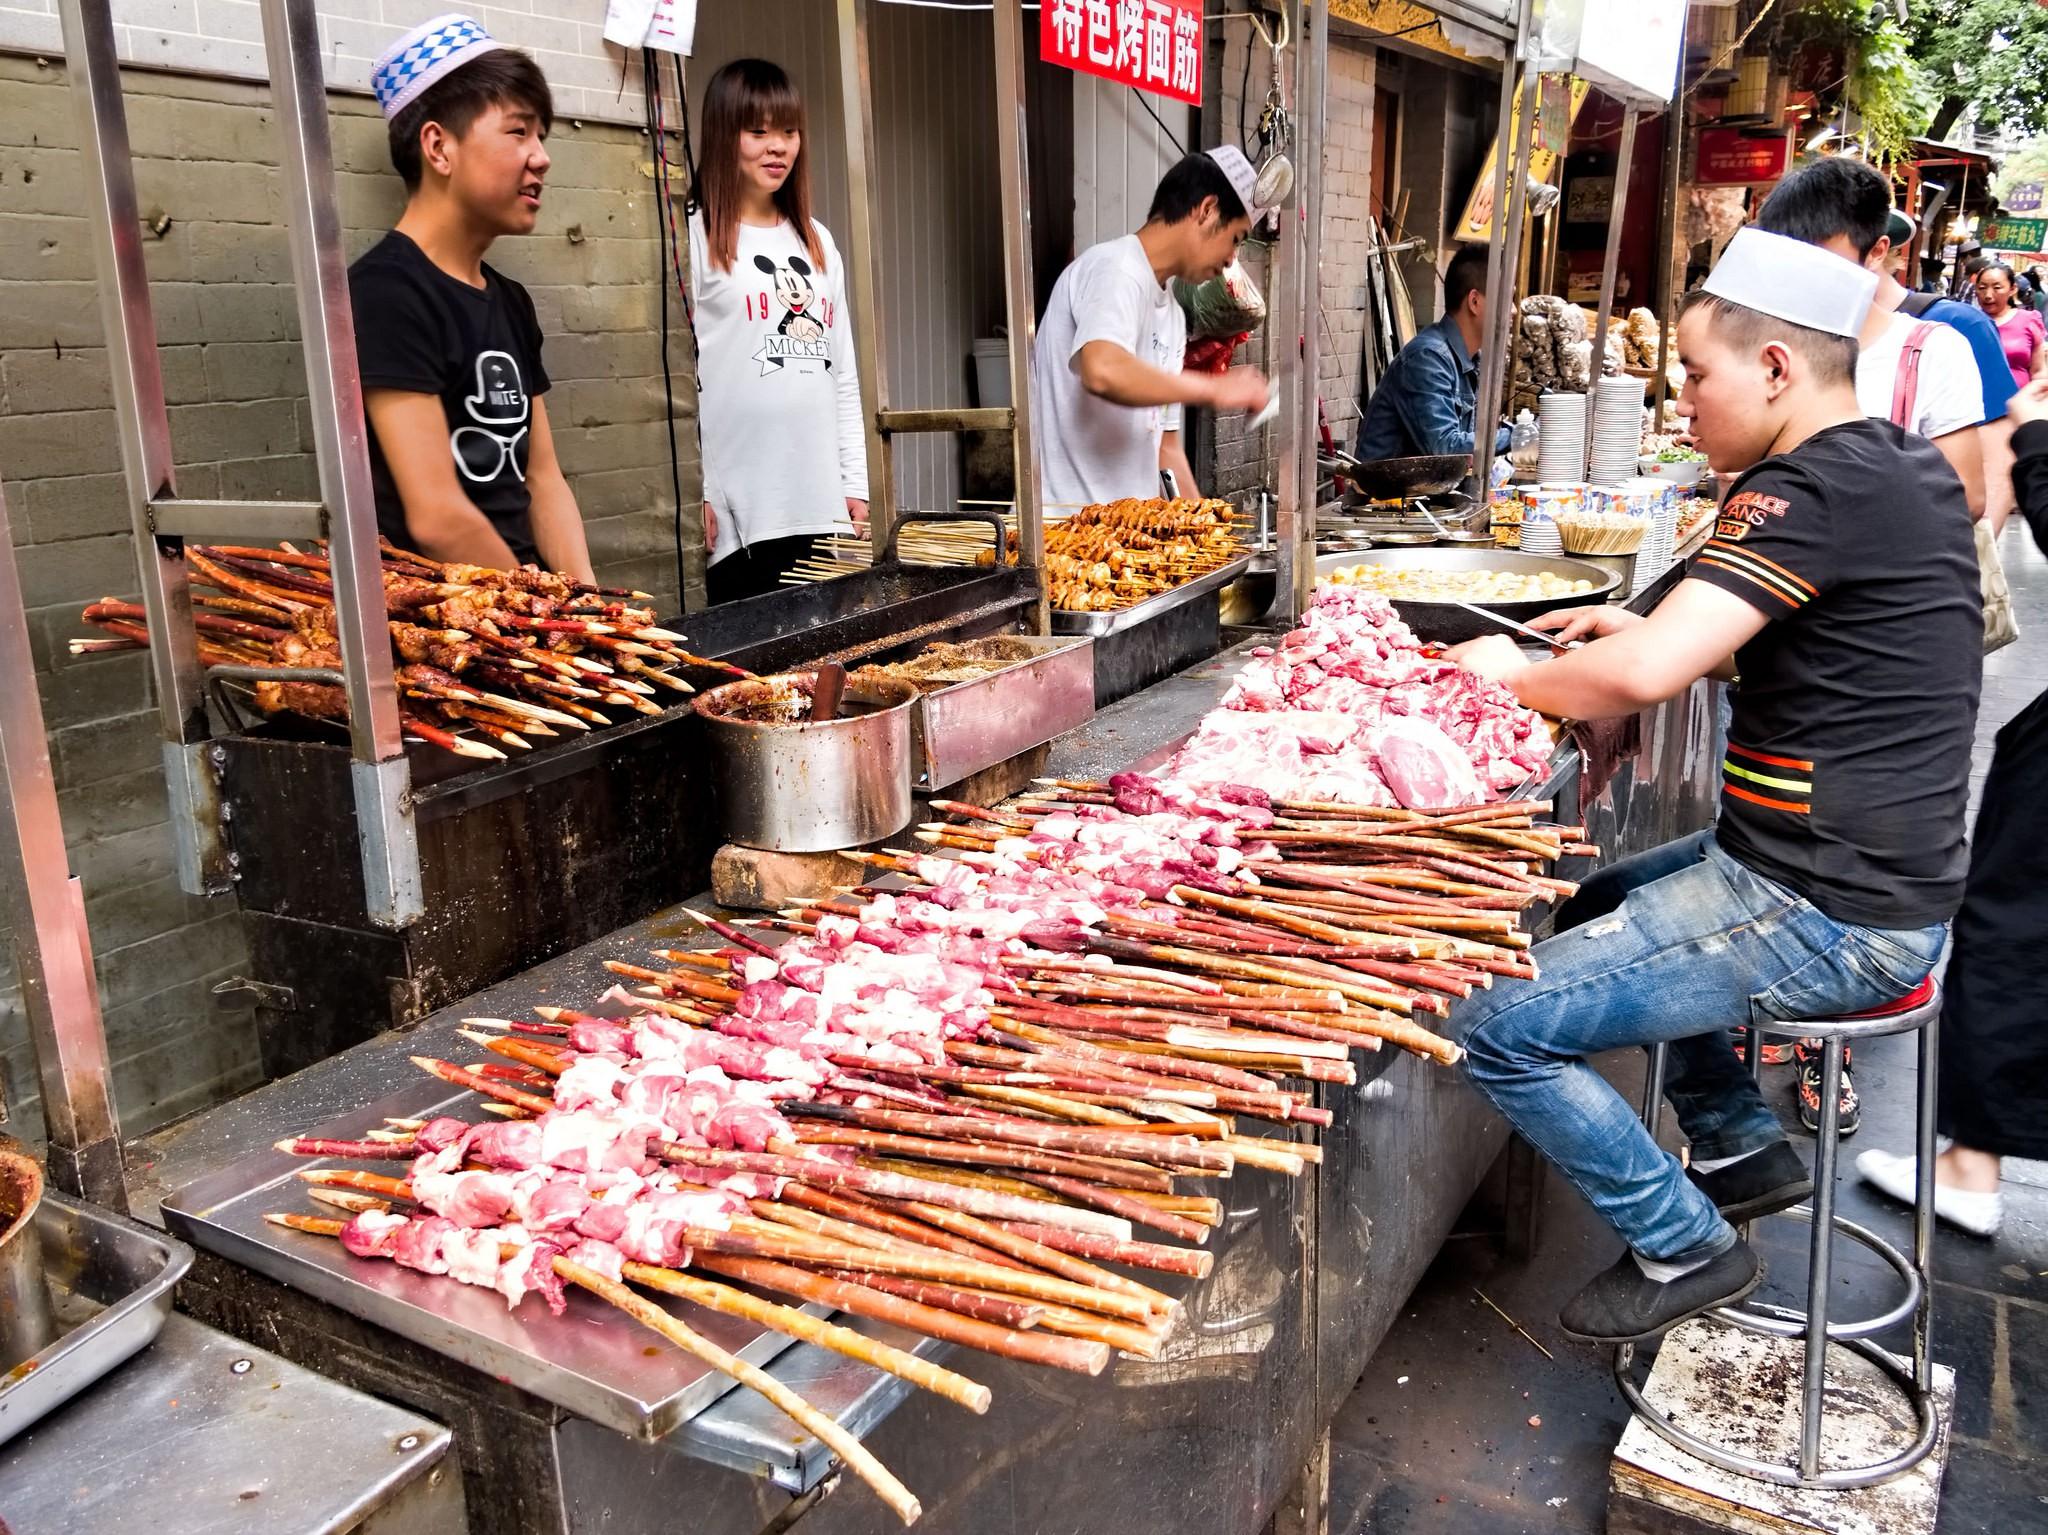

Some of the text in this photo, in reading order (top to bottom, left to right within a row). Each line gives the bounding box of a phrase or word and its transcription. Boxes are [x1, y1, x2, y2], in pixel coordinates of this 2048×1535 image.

[1051, 0, 1199, 95] 特色烤面筋
